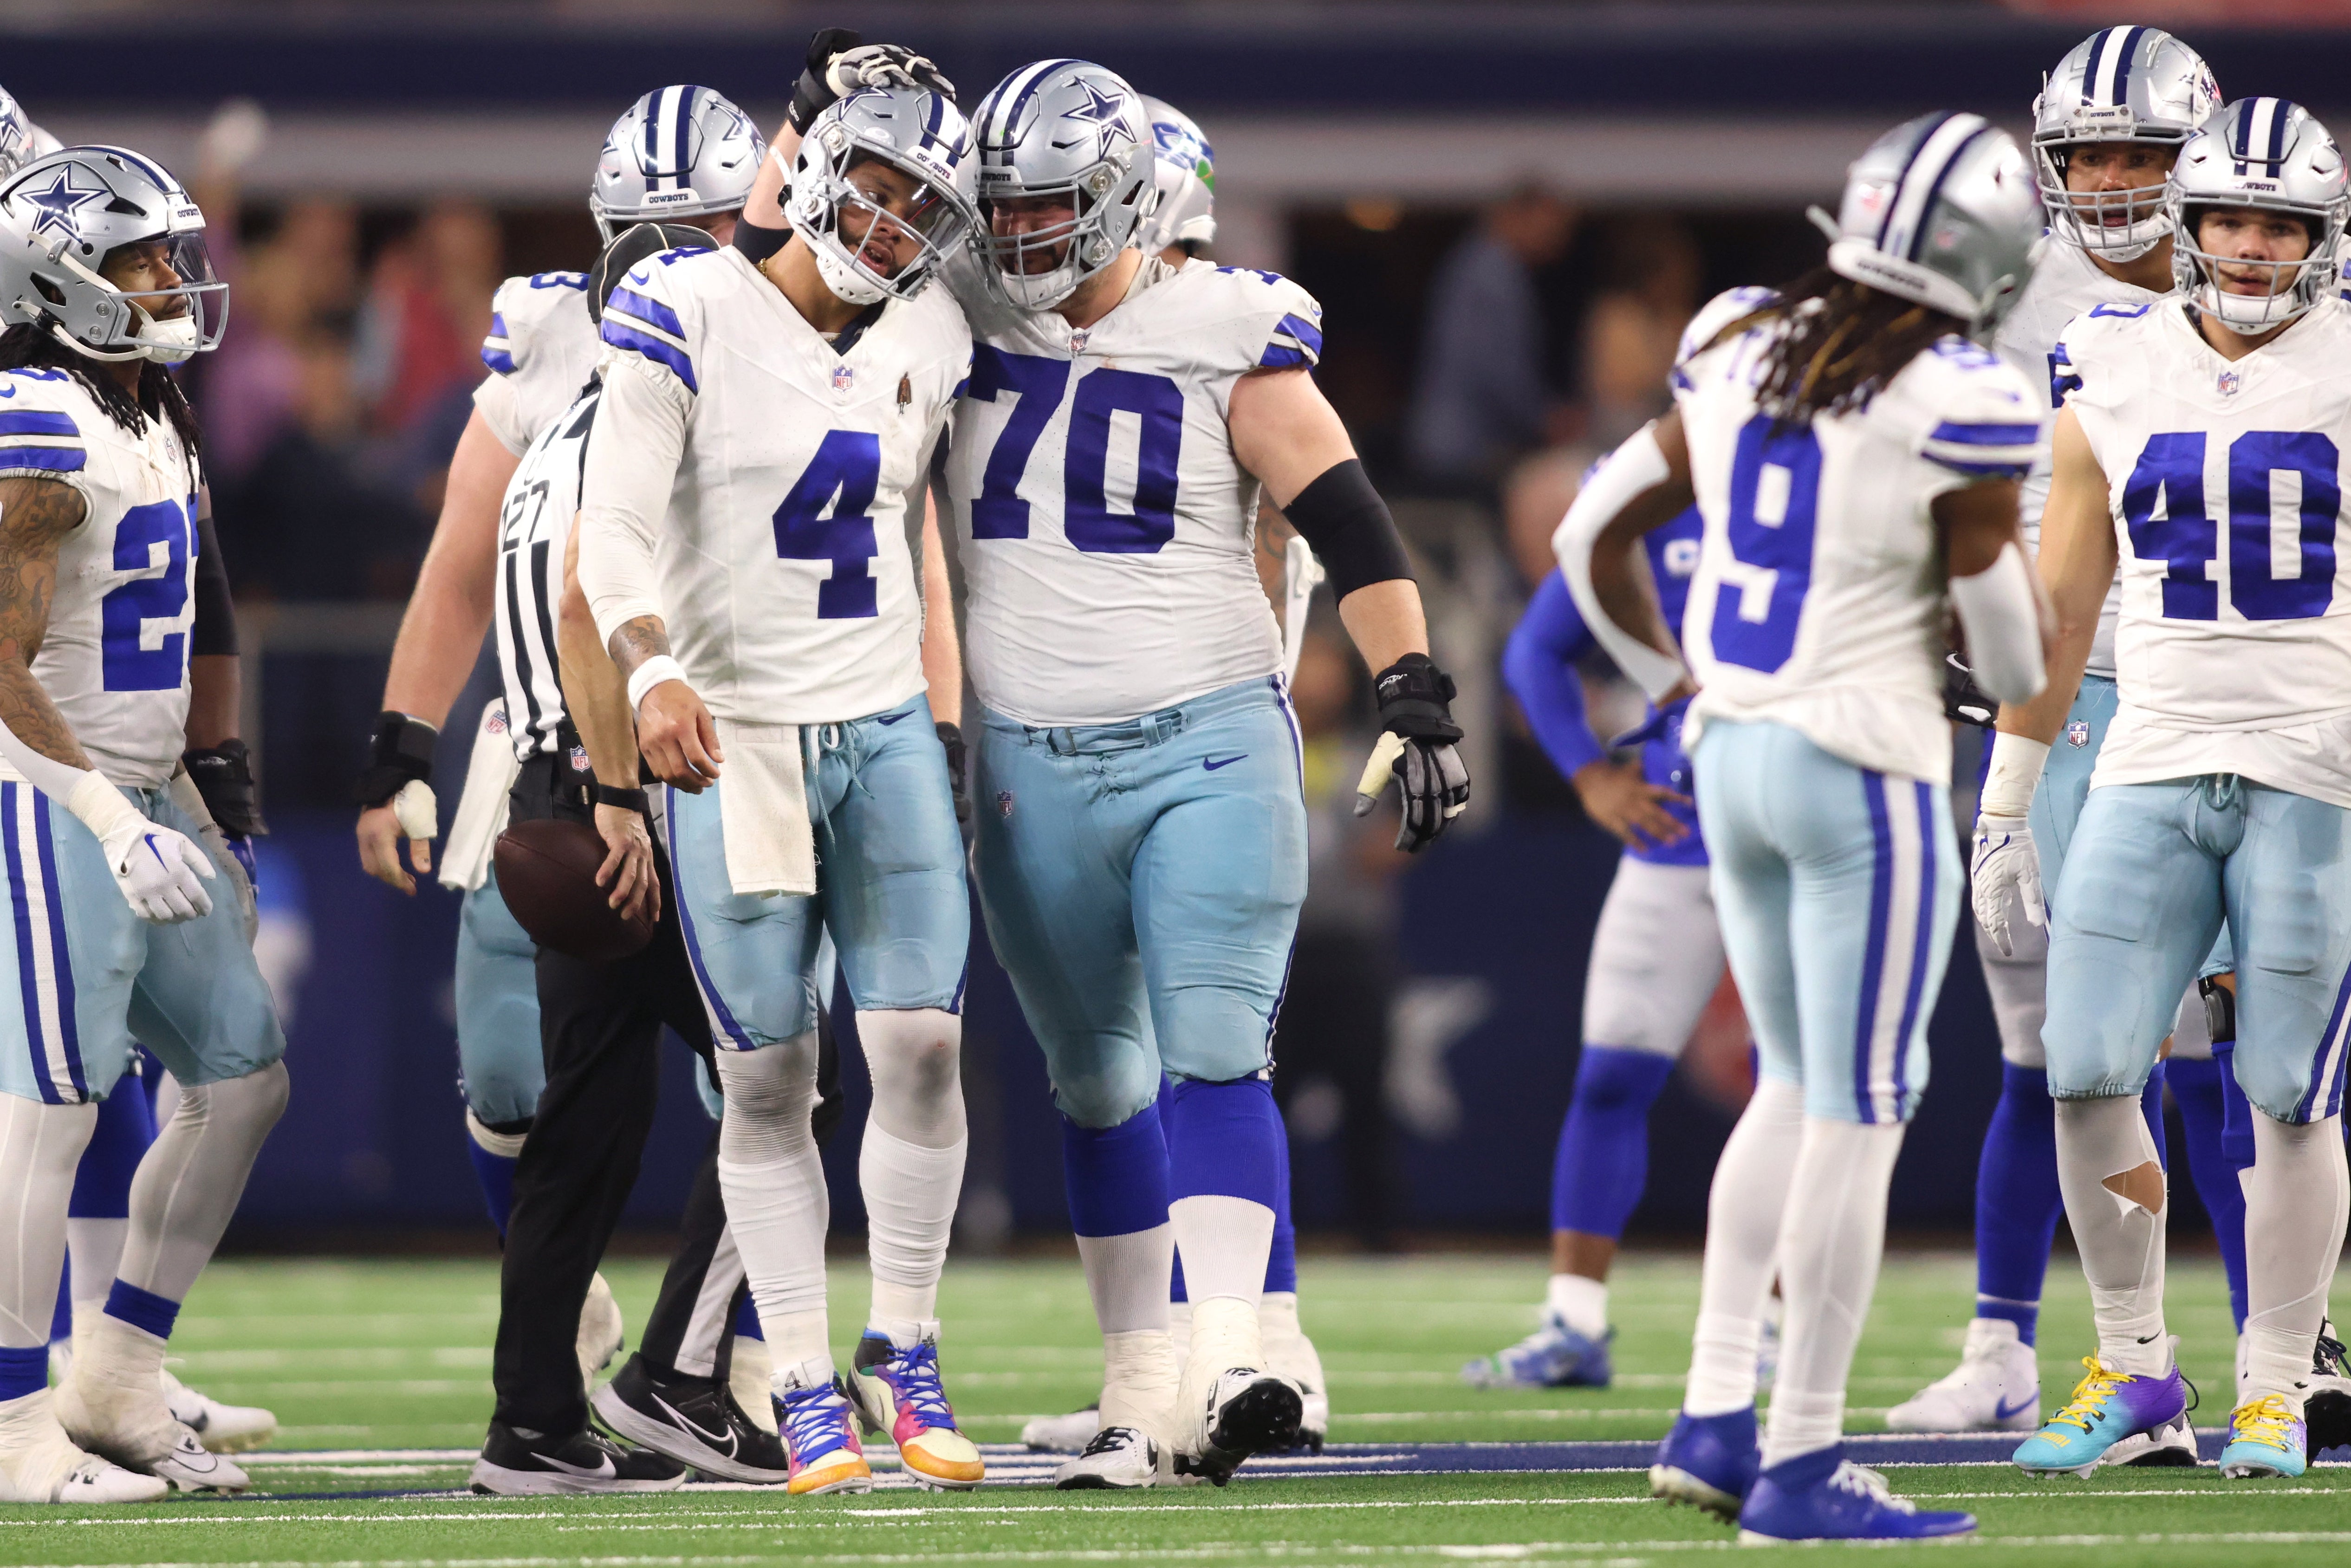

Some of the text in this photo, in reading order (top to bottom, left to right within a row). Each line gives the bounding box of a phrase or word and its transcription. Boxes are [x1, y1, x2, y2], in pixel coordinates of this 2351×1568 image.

[649, 193, 688, 203] COWBOYS
[836, 377, 851, 388] NFL
[968, 341, 1184, 554] 70
[773, 429, 880, 619] 4
[1710, 411, 1824, 674] 9
[2122, 431, 2341, 621] 40
[102, 493, 199, 691] 2
[488, 718, 505, 732] NFL
[574, 757, 588, 768] NFL
[2071, 732, 2085, 744] NFL
